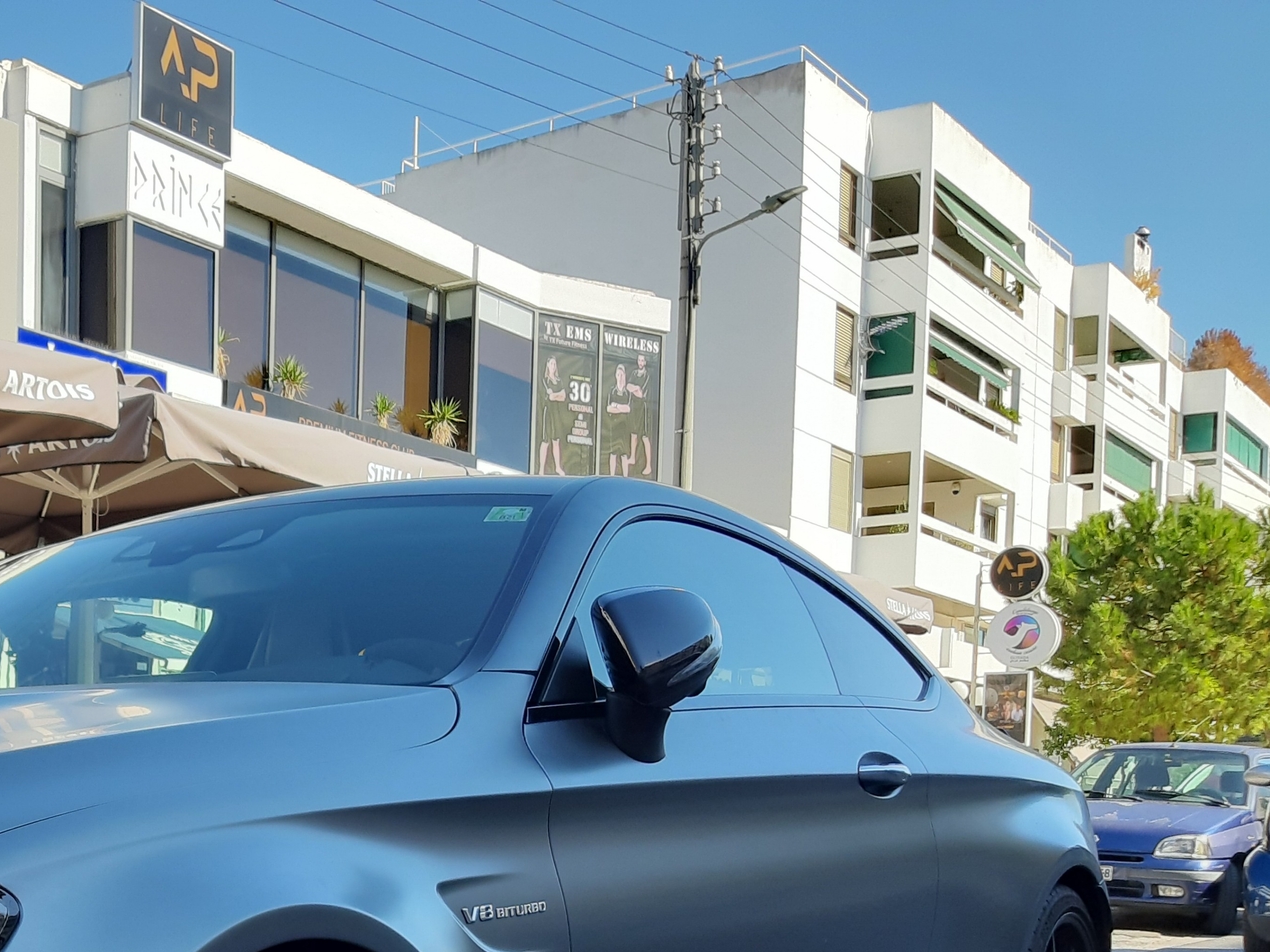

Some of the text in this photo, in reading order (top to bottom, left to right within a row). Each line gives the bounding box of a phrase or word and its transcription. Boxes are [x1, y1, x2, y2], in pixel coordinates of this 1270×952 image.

[160, 102, 216, 148] LIFE
[544, 321, 660, 354] TX EMS WIRELESS
[2, 369, 95, 401] ARTOIS
[462, 901, 546, 923] V8 BITURBO
